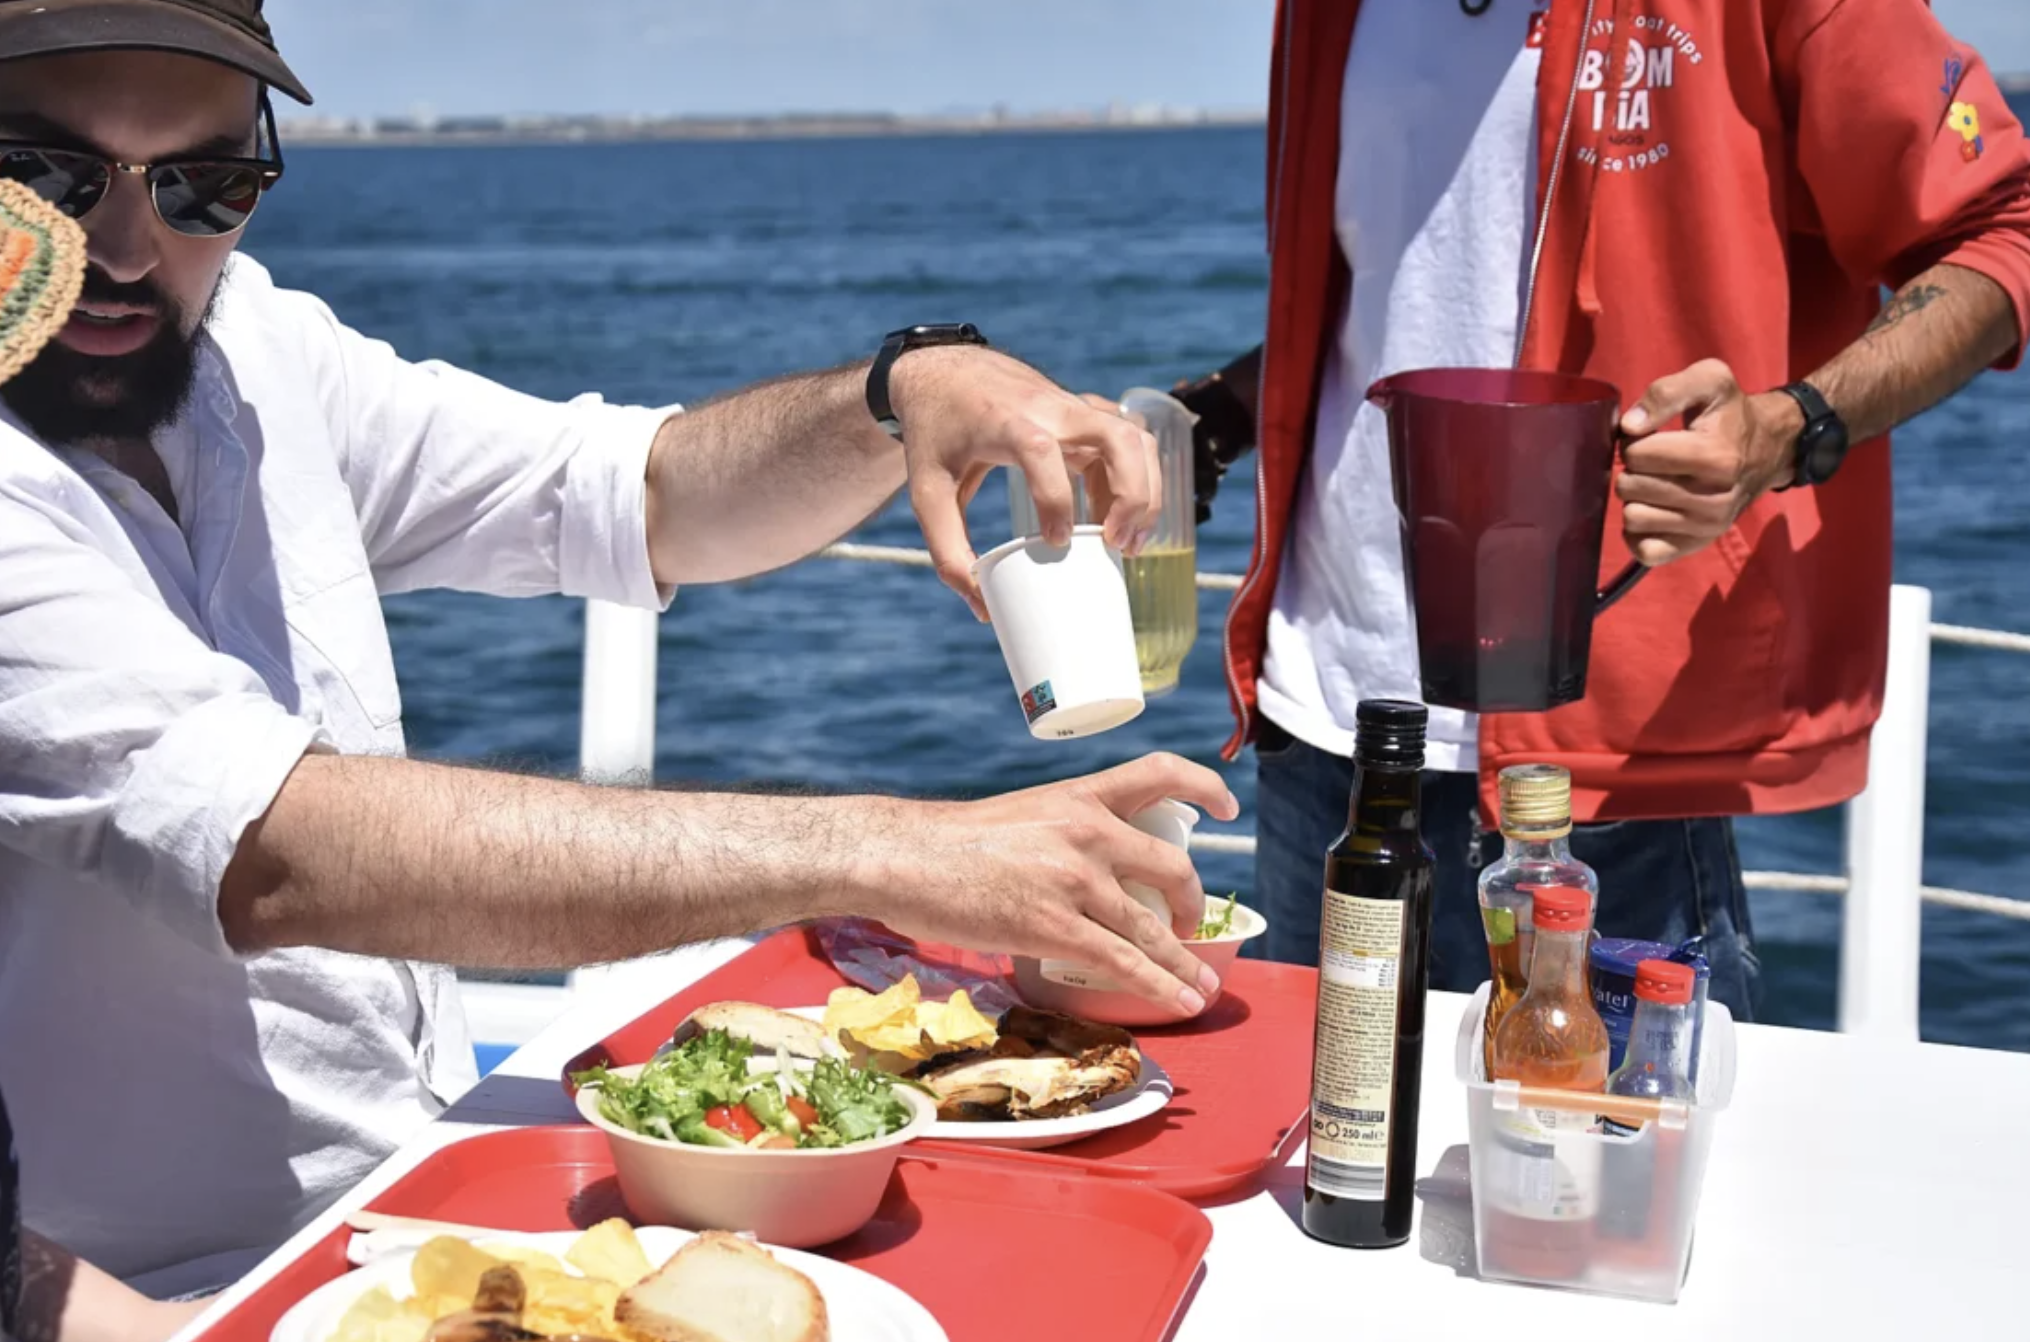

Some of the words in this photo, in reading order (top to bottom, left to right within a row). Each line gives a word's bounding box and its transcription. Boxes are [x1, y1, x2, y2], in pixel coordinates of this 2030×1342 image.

[1666, 22, 1702, 64] trips
[1627, 143, 1669, 170] 1980
[1593, 987, 1628, 1009] atel
[1342, 1127, 1360, 1139] 250
